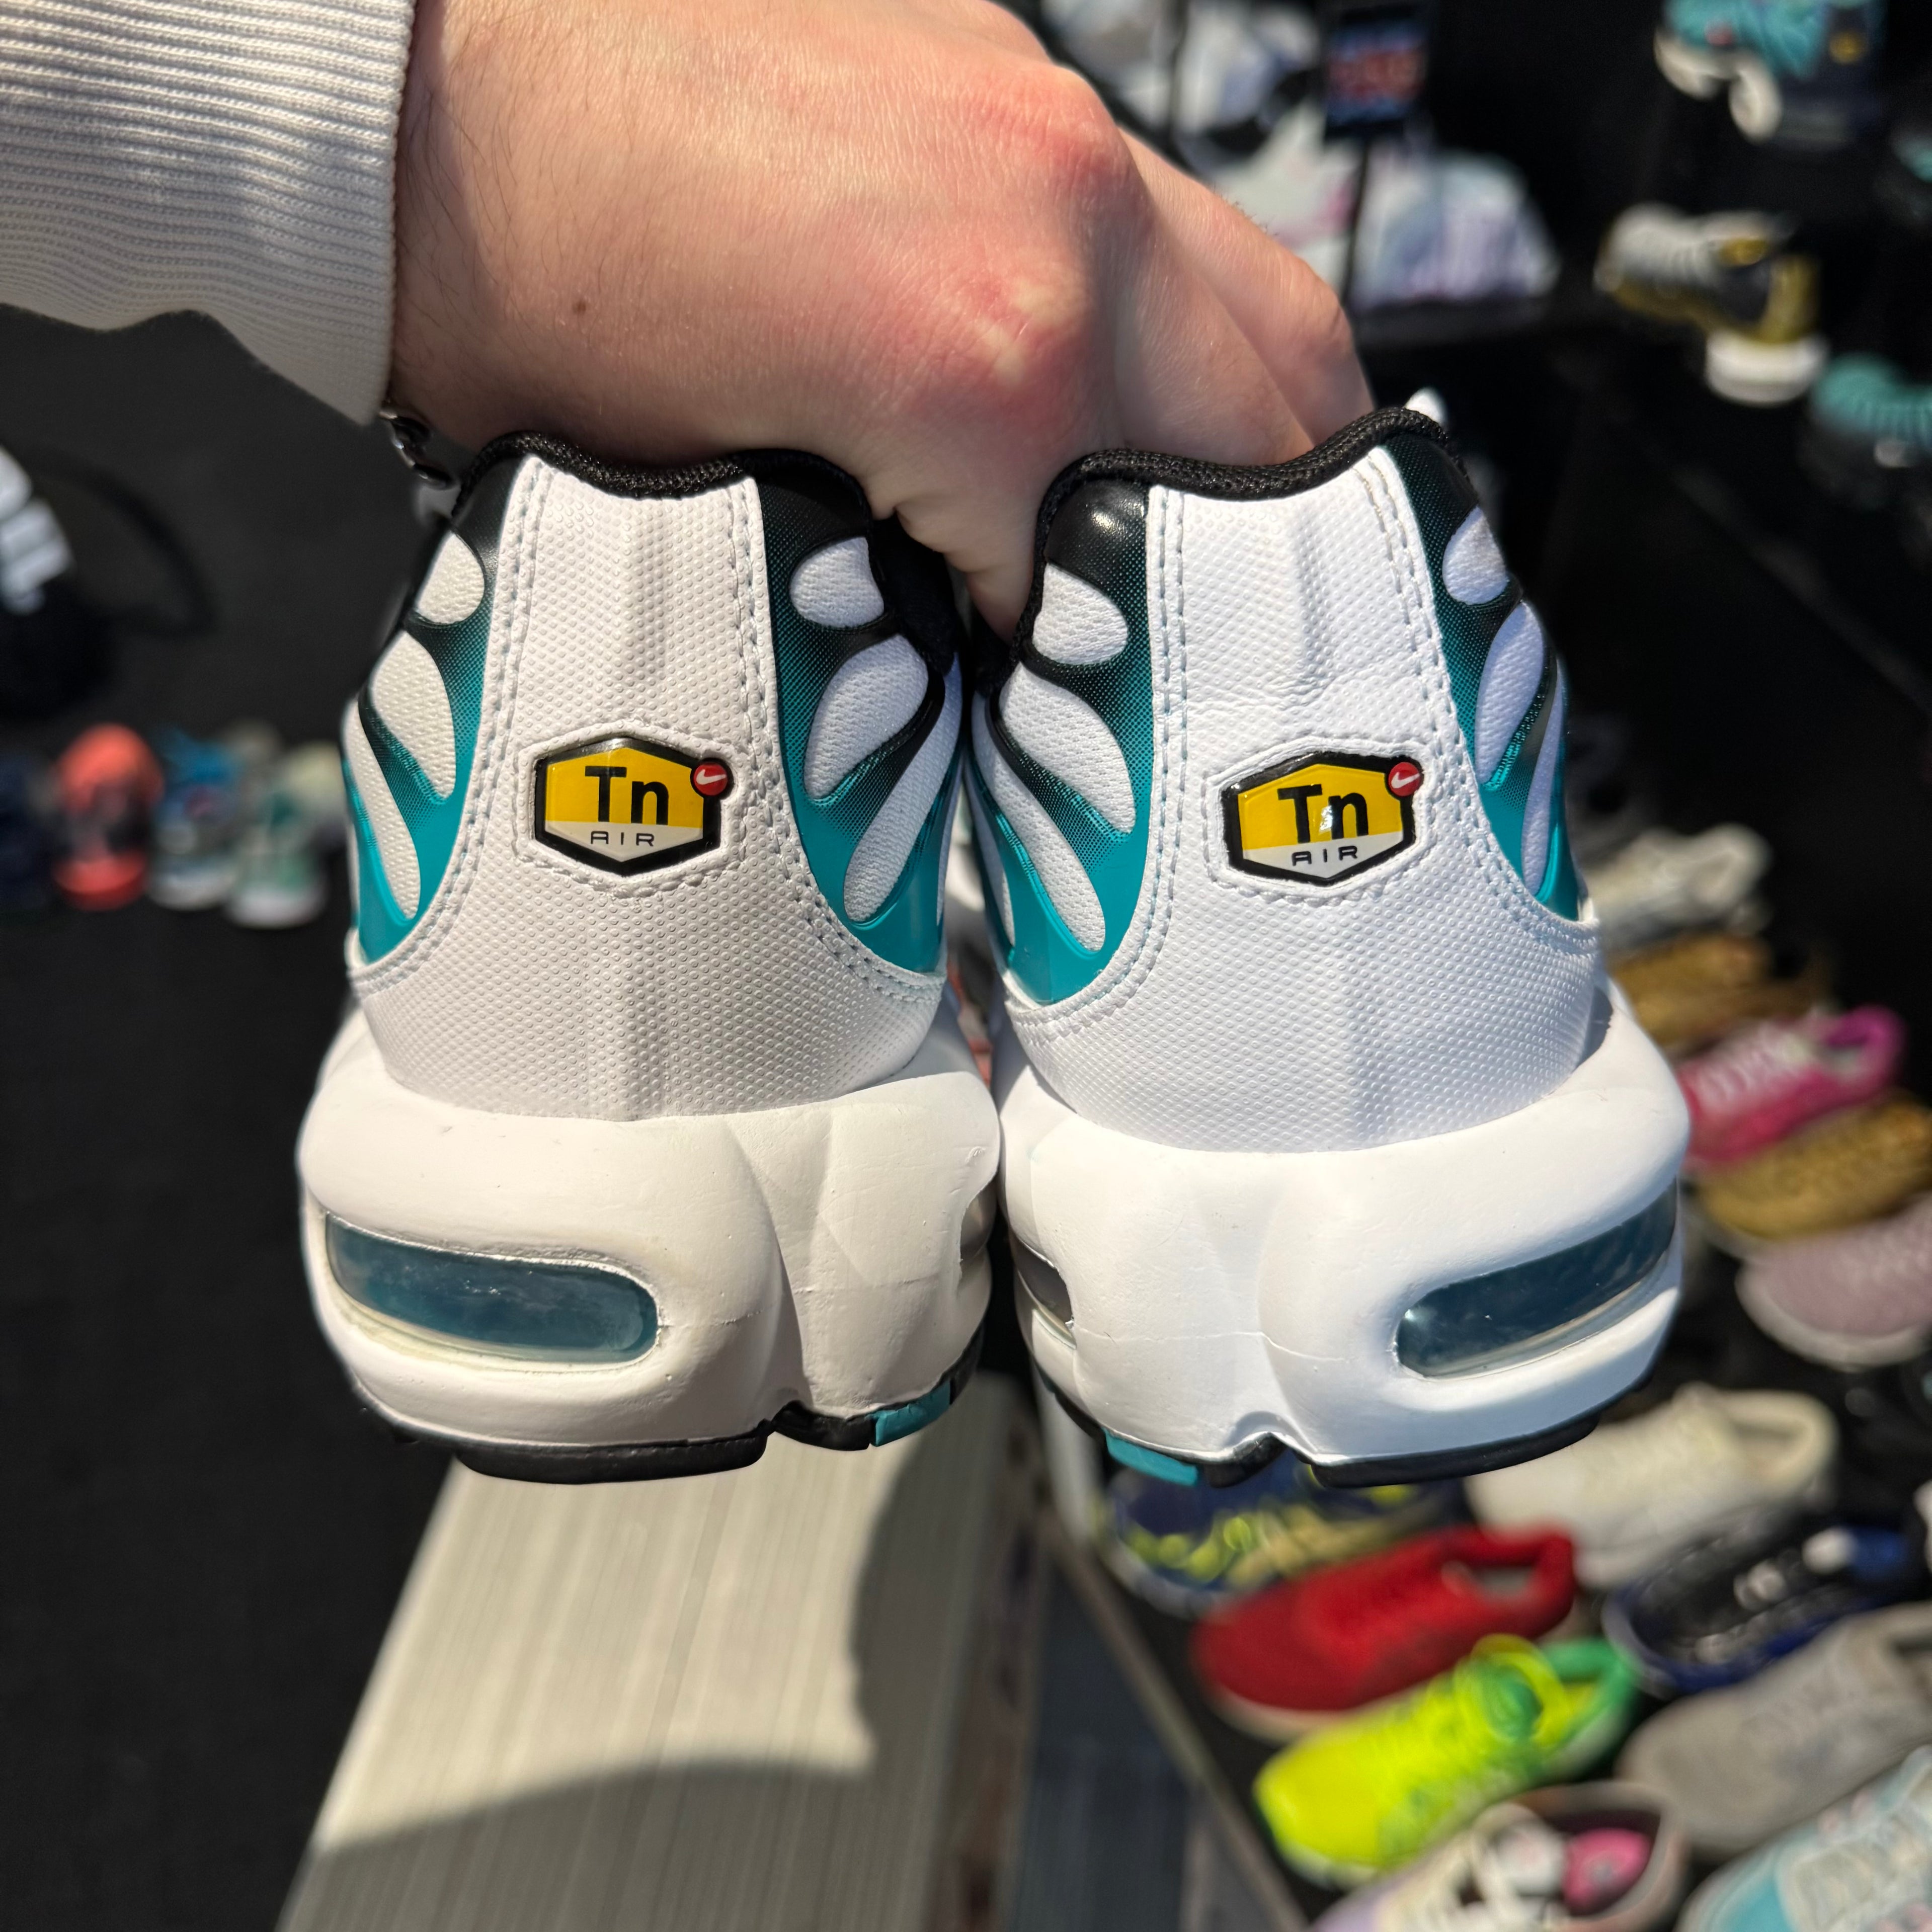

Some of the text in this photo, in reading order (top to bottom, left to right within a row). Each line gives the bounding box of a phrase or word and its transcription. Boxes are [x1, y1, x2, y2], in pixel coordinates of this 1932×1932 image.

[585, 765, 669, 825] Tn
[1277, 783, 1369, 844] Tn
[591, 831, 655, 847] AIR
[1292, 845, 1358, 866] AIR
